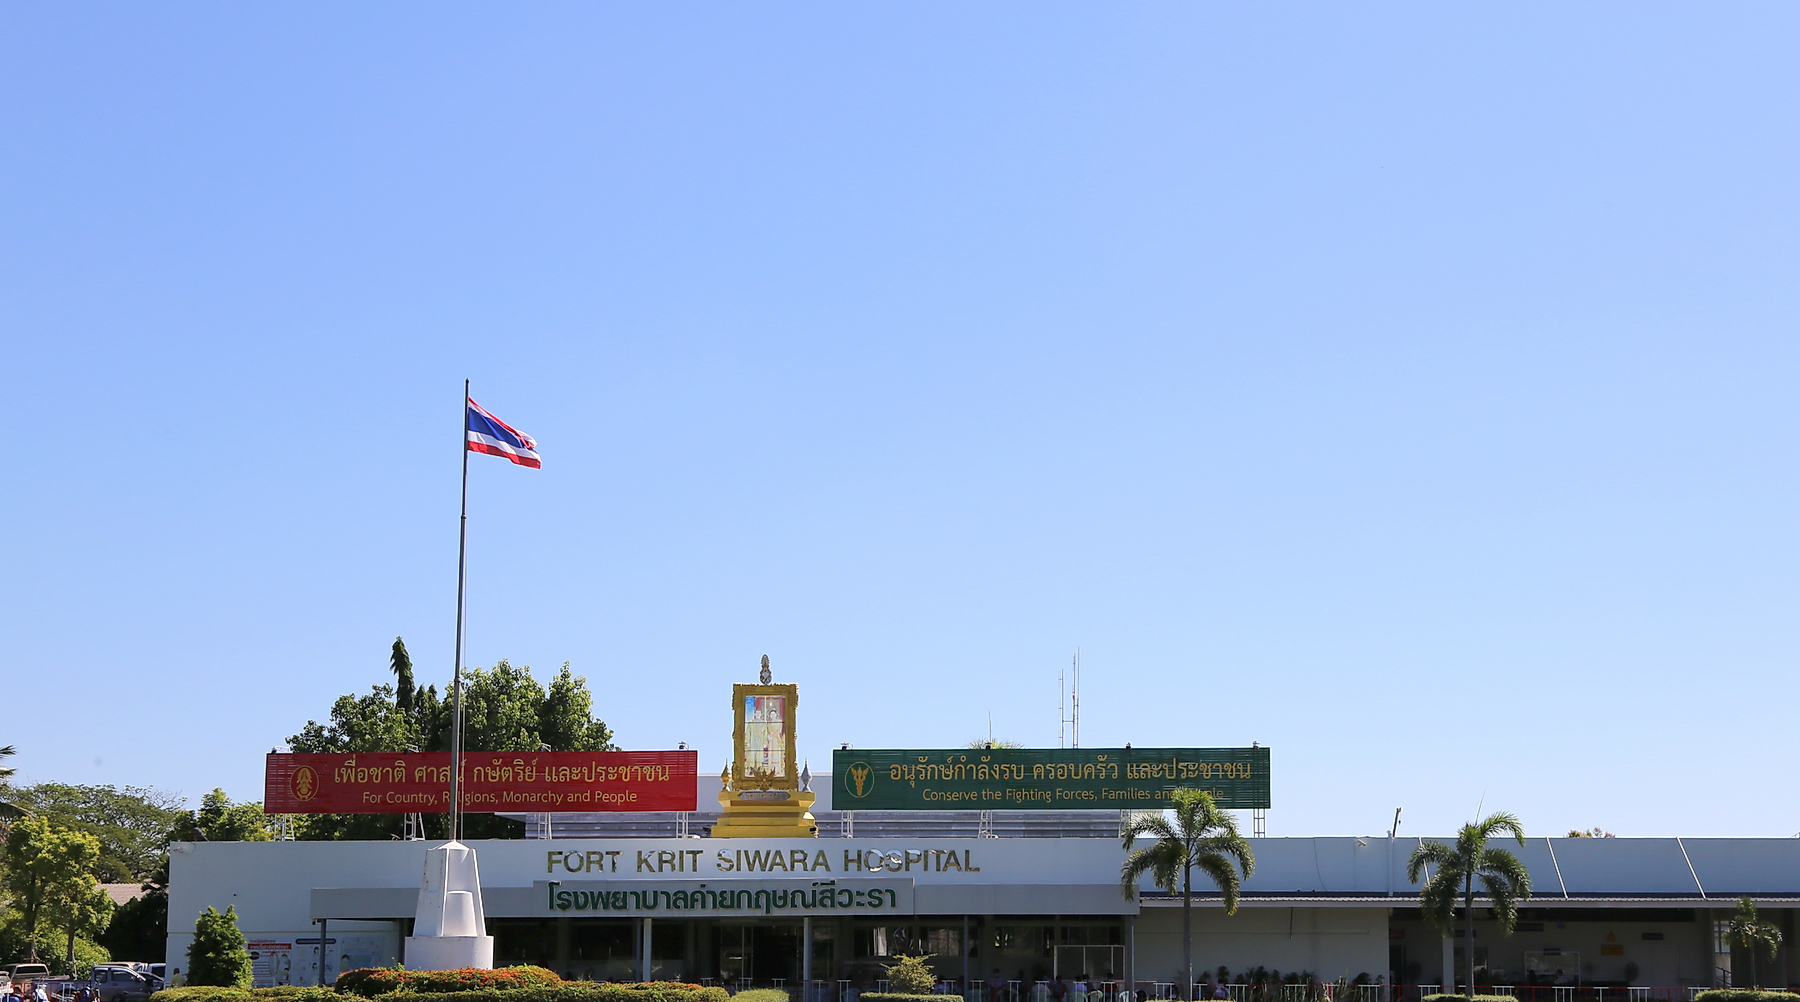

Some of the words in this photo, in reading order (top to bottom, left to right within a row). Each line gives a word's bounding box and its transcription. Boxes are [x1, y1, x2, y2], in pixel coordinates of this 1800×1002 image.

[334, 754, 406, 783] เพื่อชาติ
[473, 758, 538, 782] กษัตริย์
[545, 761, 670, 782] และประชาชน
[889, 755, 1024, 788] อนุรักษ์กำลังรบ
[1032, 755, 1119, 779] ครอบครัว
[1126, 758, 1251, 779] และประชาชน
[363, 791, 382, 803] For
[386, 791, 438, 805] Country,
[442, 791, 499, 805] Rlgions,
[502, 790, 563, 805] Monarchy
[567, 790, 590, 802] and
[595, 790, 637, 805] People
[923, 788, 978, 800] Conserve
[981, 788, 1002, 800] the
[1006, 788, 1051, 803] Fighting
[1056, 787, 1098, 801] Forces,
[1101, 787, 1150, 800] Families
[547, 849, 624, 873] FORT
[636, 849, 704, 873] KRIT
[716, 848, 832, 873] SIWARA
[843, 848, 980, 873] HOSPITAL
[547, 879, 897, 914] โรงพยาบาลค่ายกฤษณ์สีวะรา
